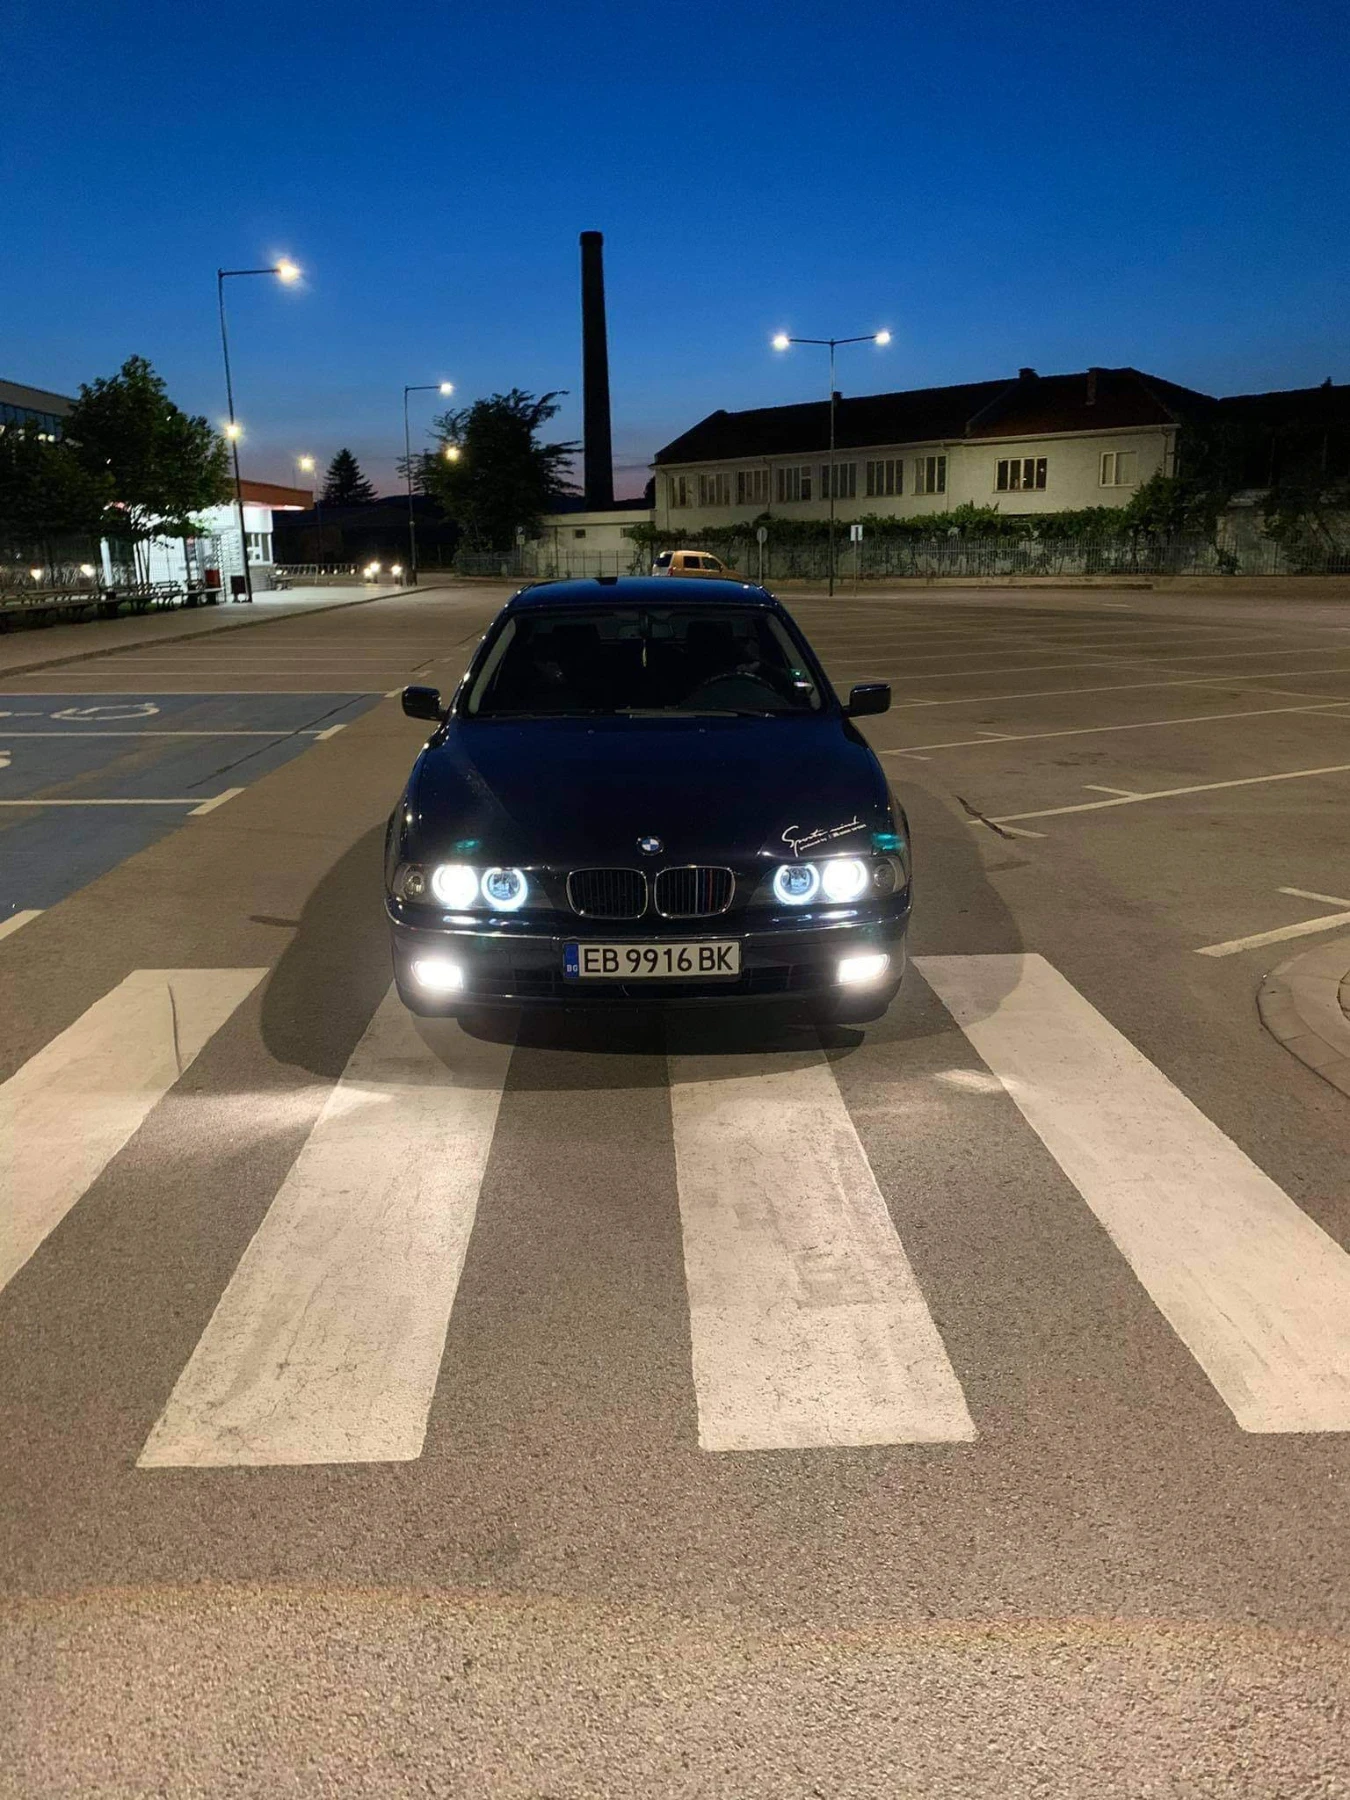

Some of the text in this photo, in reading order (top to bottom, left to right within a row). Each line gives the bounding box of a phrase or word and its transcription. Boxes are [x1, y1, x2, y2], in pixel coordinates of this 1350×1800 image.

[566, 964, 578, 972] BG
[584, 946, 733, 973] EB 9916 BK
